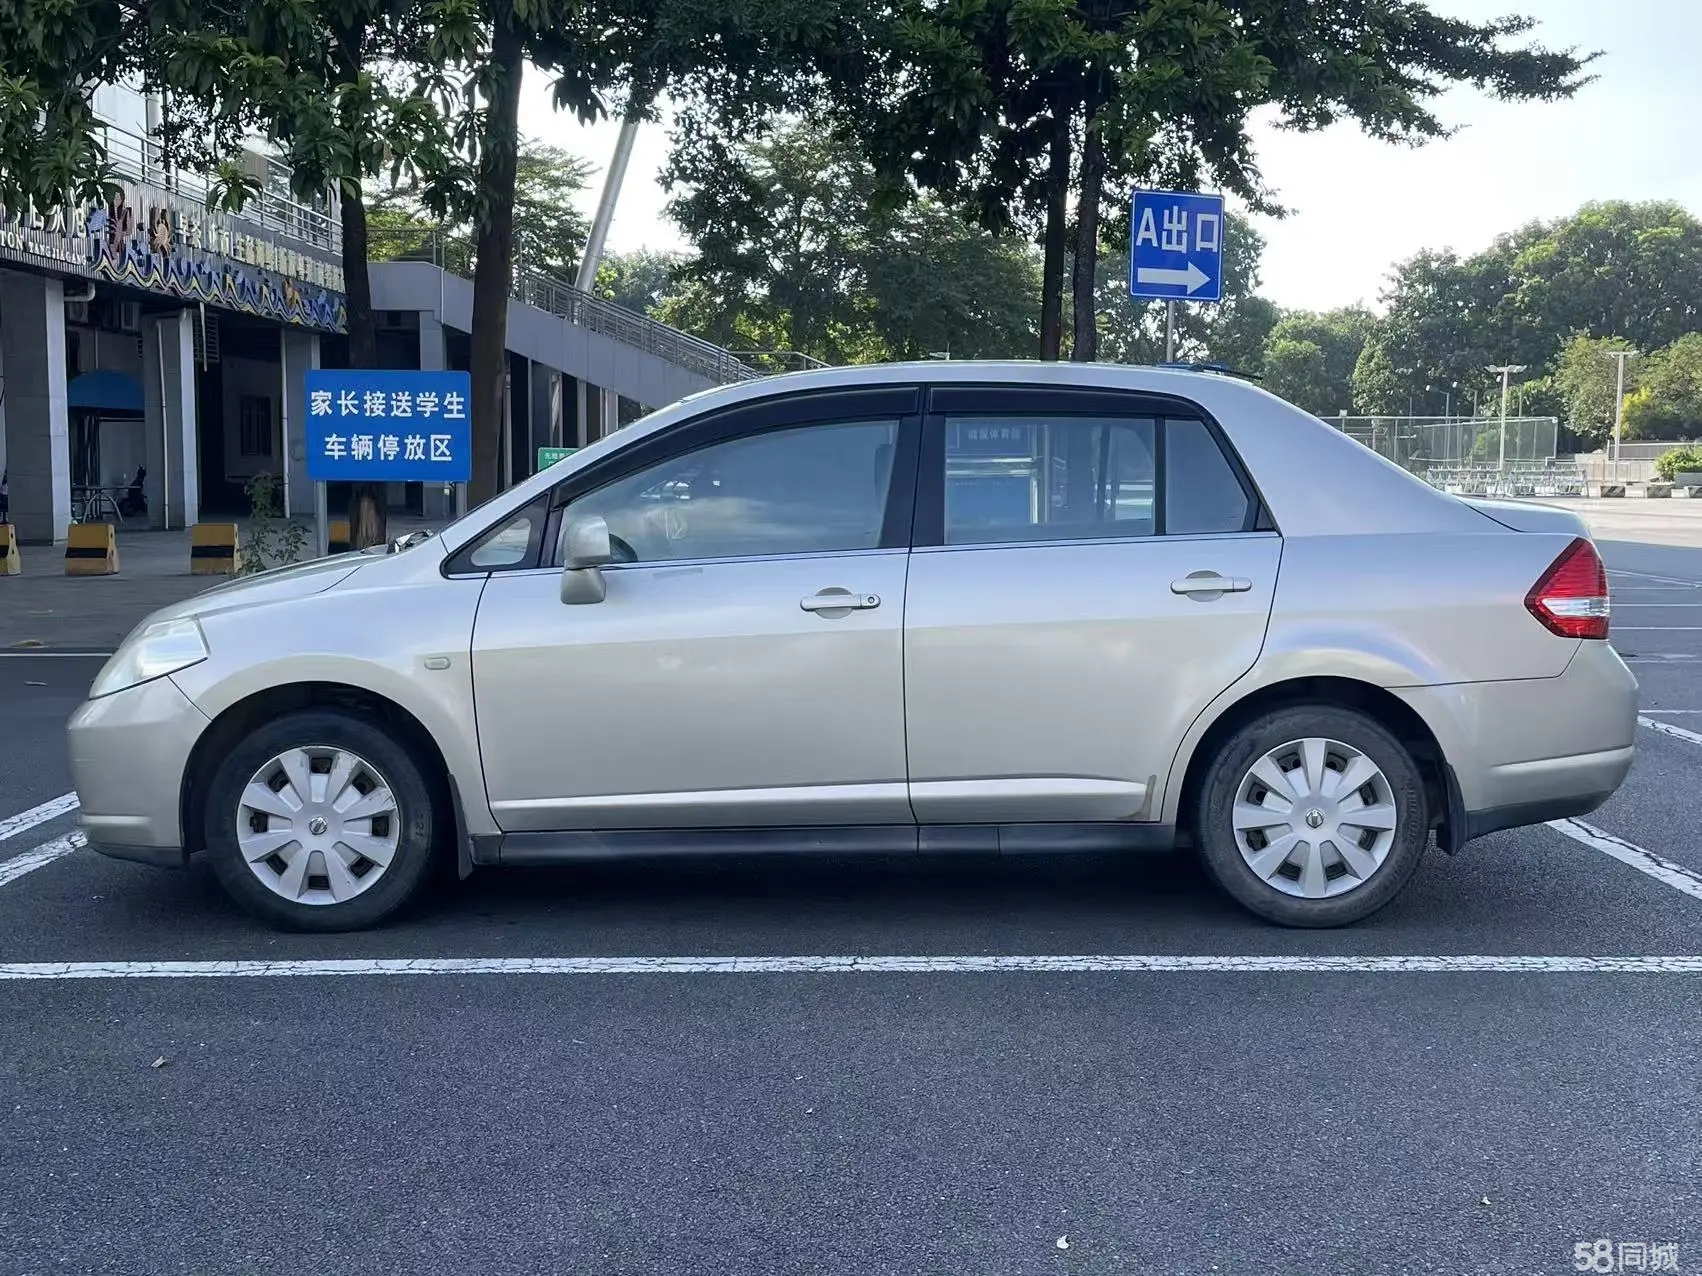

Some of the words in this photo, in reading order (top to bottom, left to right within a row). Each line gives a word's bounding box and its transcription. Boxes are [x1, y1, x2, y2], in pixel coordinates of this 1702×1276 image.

[1135, 205, 1219, 254] A出口
[311, 391, 466, 418] 家长接送学生
[324, 434, 452, 461] 车辆停放区
